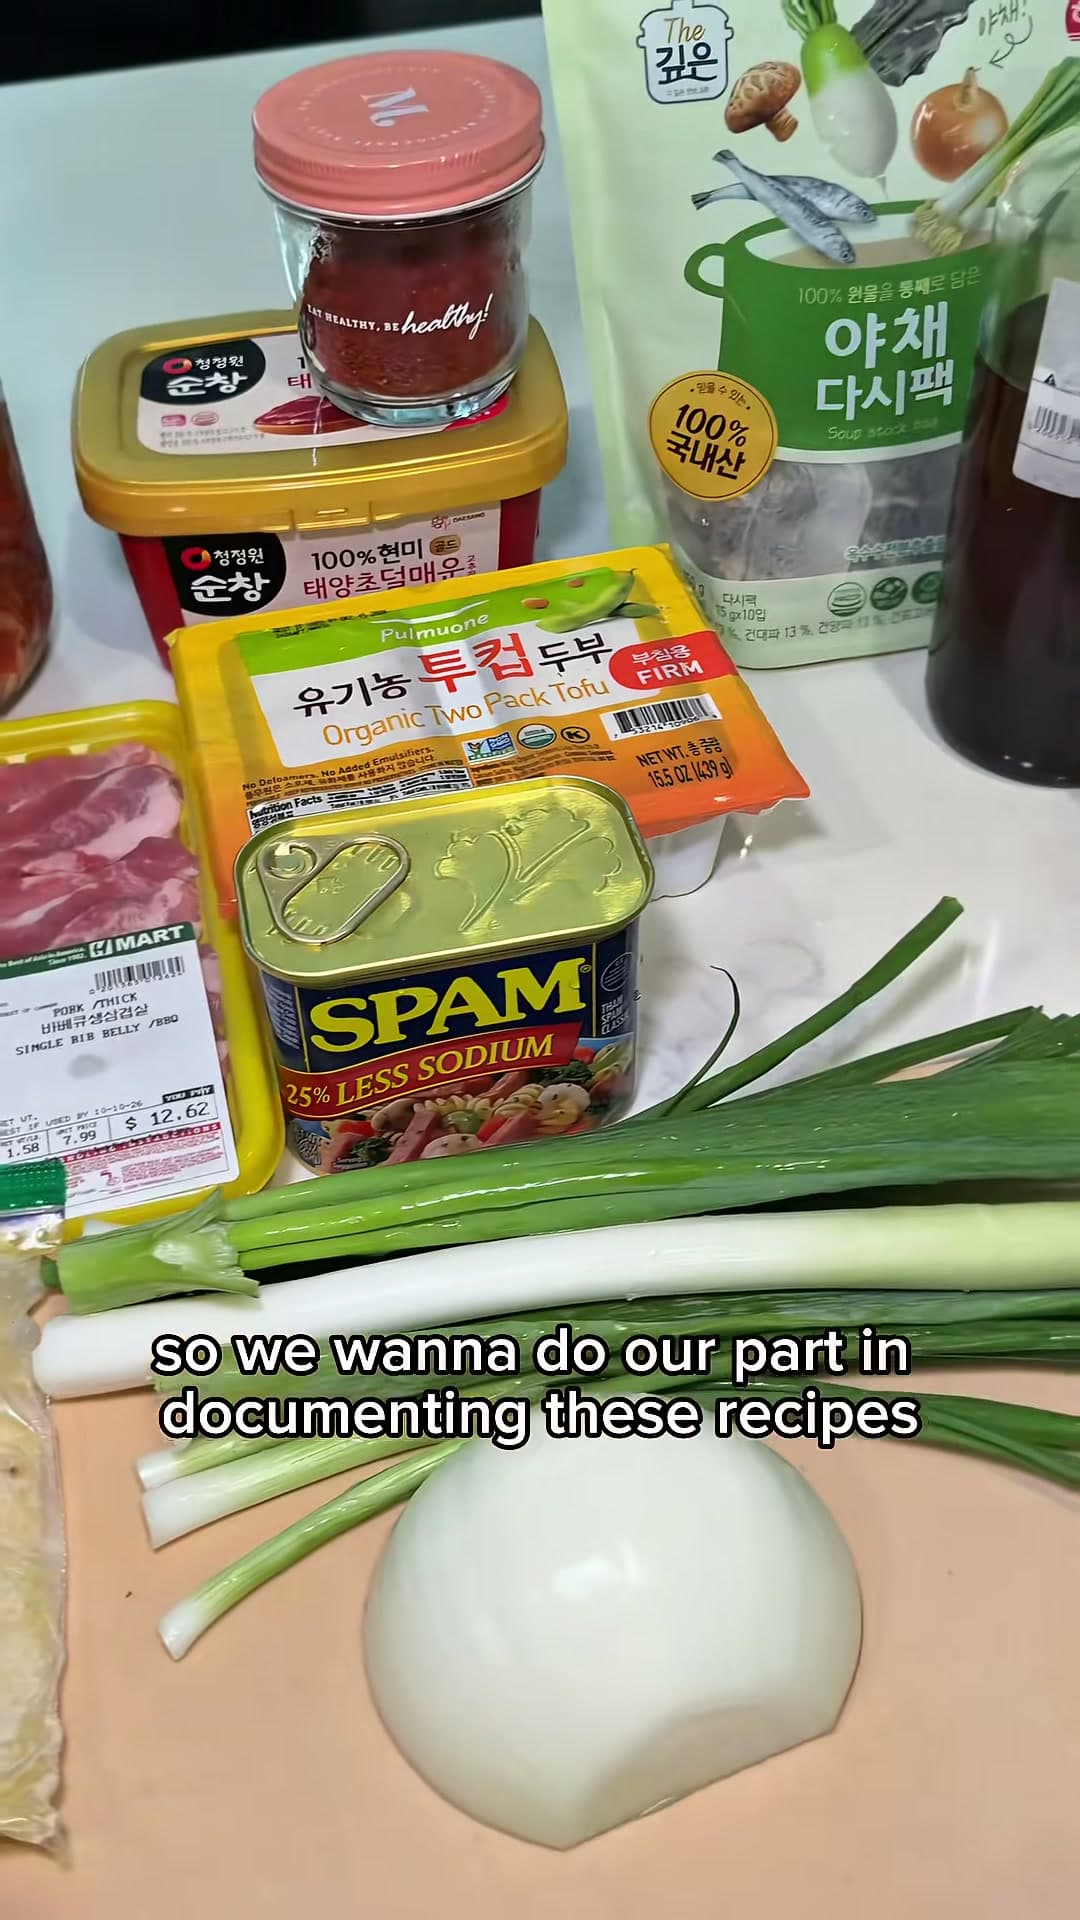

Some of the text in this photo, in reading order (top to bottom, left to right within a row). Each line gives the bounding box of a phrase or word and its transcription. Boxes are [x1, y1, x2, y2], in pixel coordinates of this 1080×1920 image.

[663, 17, 705, 43] The
[656, 42, 718, 85] 깊은
[799, 287, 842, 304] 100%
[384, 322, 400, 332] BE
[402, 293, 494, 340] healthy!
[825, 301, 948, 369] 야채
[195, 355, 244, 370] 청정원
[167, 372, 248, 397] 순창
[816, 359, 954, 421] 다시팩
[675, 403, 749, 447] 100%
[666, 430, 746, 480] 국내산
[213, 548, 265, 567] 청정원
[190, 571, 270, 602] 순창
[381, 614, 489, 642] Pulmuone
[293, 632, 613, 717] 유기농 투컵 두부
[637, 660, 703, 685] FIRM
[322, 678, 610, 746] Organic Two Pack Tofu
[242, 783, 257, 791] No
[321, 769, 336, 777] No
[339, 761, 371, 774] Added
[372, 746, 435, 767] Emulsifiers.
[636, 748, 664, 767] NET
[661, 745, 689, 762] WT.
[648, 767, 674, 788] 15.5
[675, 765, 693, 784] OZ
[691, 759, 719, 782] (439
[295, 795, 323, 808] Facts
[115, 925, 185, 951] MART
[41, 1003, 149, 1035] 바베큐생삼겹살
[53, 1003, 85, 1018] PORK
[92, 992, 138, 1010] /THICK
[310, 957, 589, 1053] SPAM
[16, 1014, 179, 1056] SINGLE RIB BELLY /BBQ
[287, 1034, 554, 1108] 25% LESS SODIUM
[125, 1102, 211, 1131] $ 12.62
[8, 1142, 40, 1158] 1.58
[62, 1130, 97, 1146] 7.99
